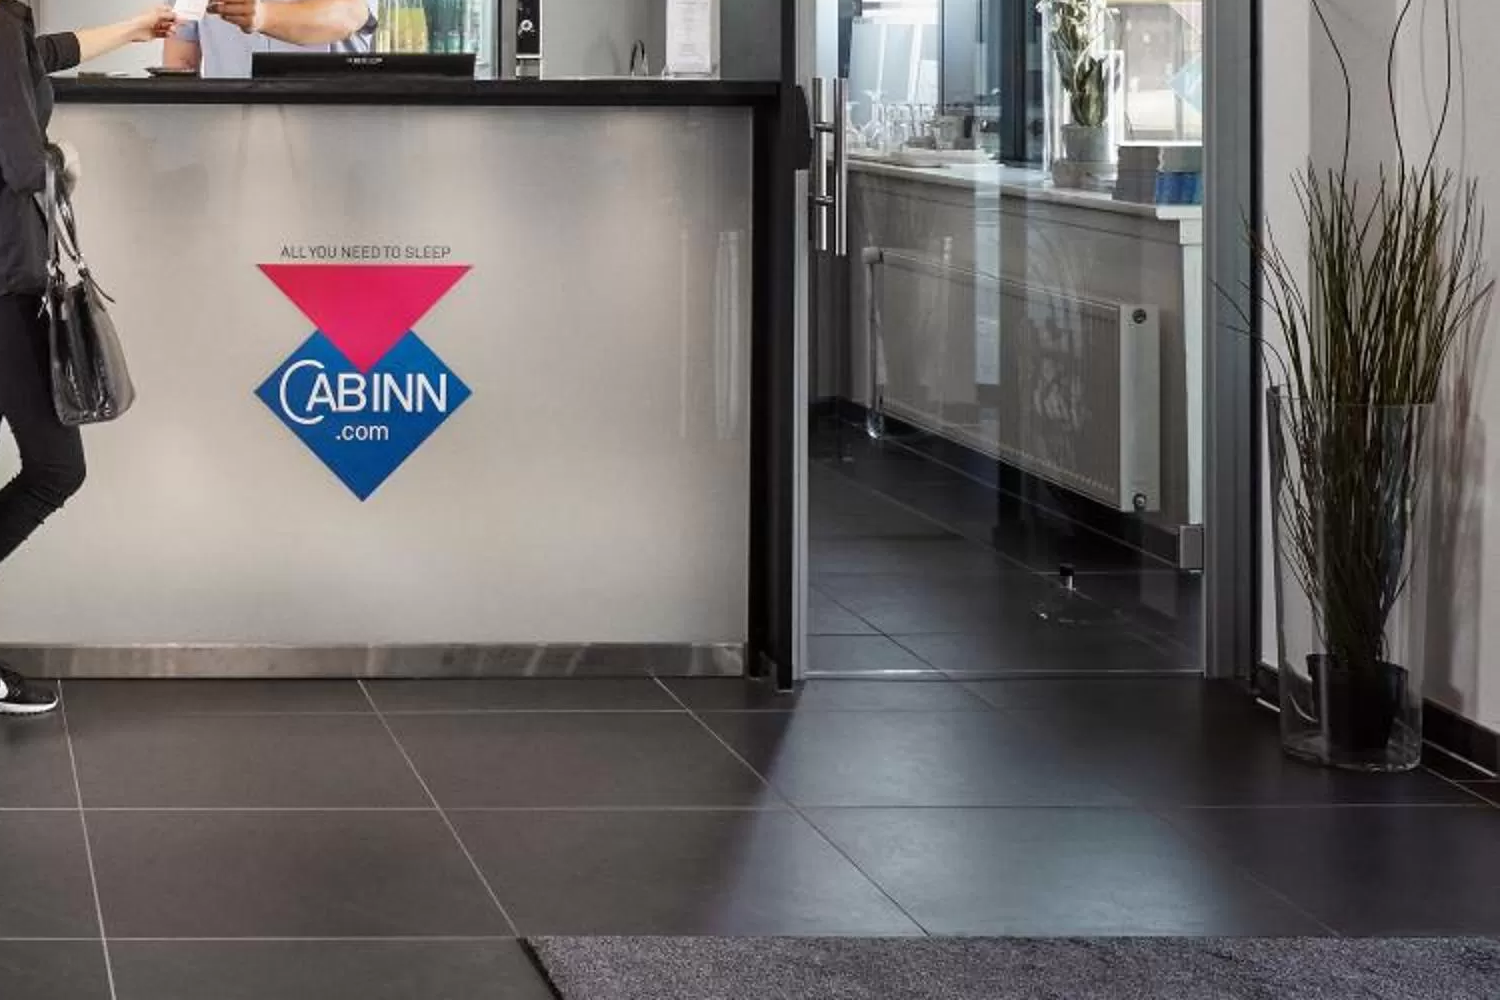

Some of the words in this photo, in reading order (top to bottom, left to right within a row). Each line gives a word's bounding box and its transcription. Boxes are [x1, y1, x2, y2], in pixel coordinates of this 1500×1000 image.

[280, 245, 307, 259] ALL
[308, 245, 338, 259] YOU
[341, 245, 381, 259] NEED
[384, 245, 401, 259] TO
[405, 245, 451, 259] SLEEP
[279, 359, 448, 425] CABINN
[335, 425, 389, 441] .com
